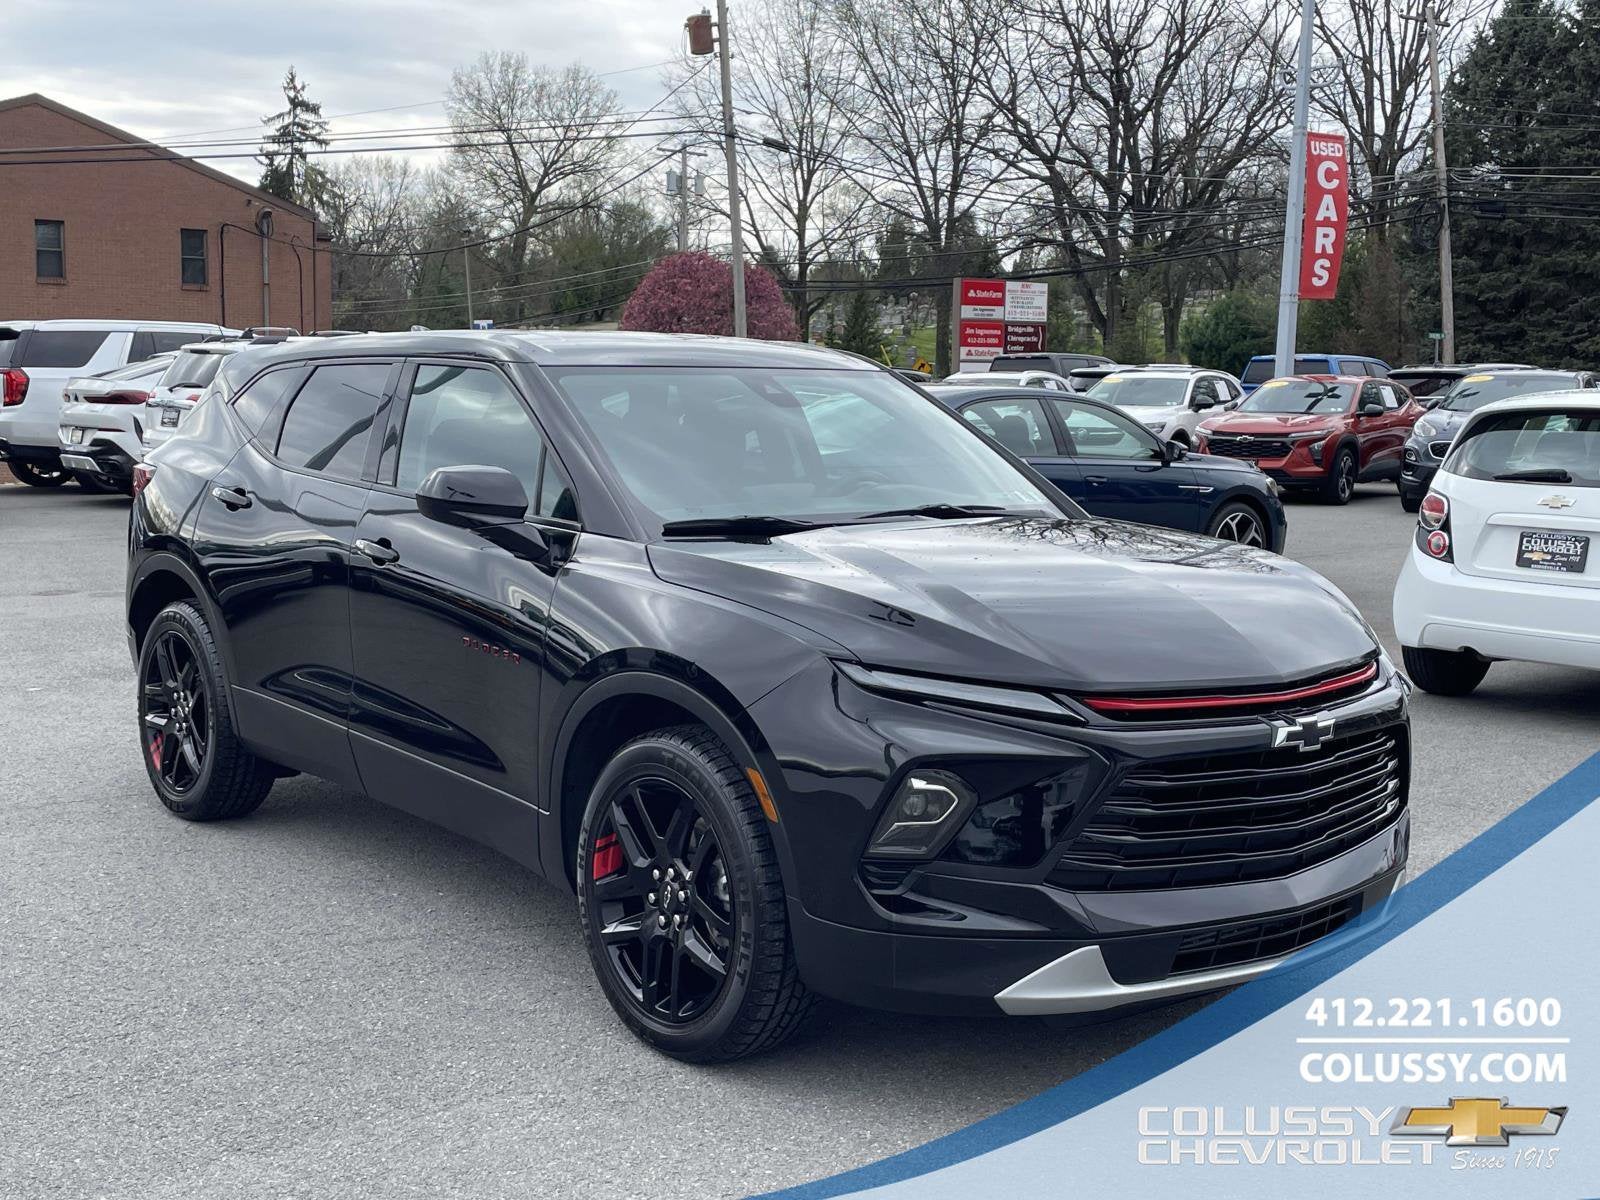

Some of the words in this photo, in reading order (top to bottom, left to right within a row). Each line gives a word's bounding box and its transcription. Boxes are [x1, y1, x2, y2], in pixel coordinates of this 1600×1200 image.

[1310, 141, 1343, 157] USED
[1311, 160, 1340, 287] CARS
[1007, 325, 1034, 333] Bridgeville
[1007, 335, 1038, 343] Chiropractic
[1522, 537, 1585, 550] COLUSSY
[1522, 544, 1583, 555] CHEVROLET
